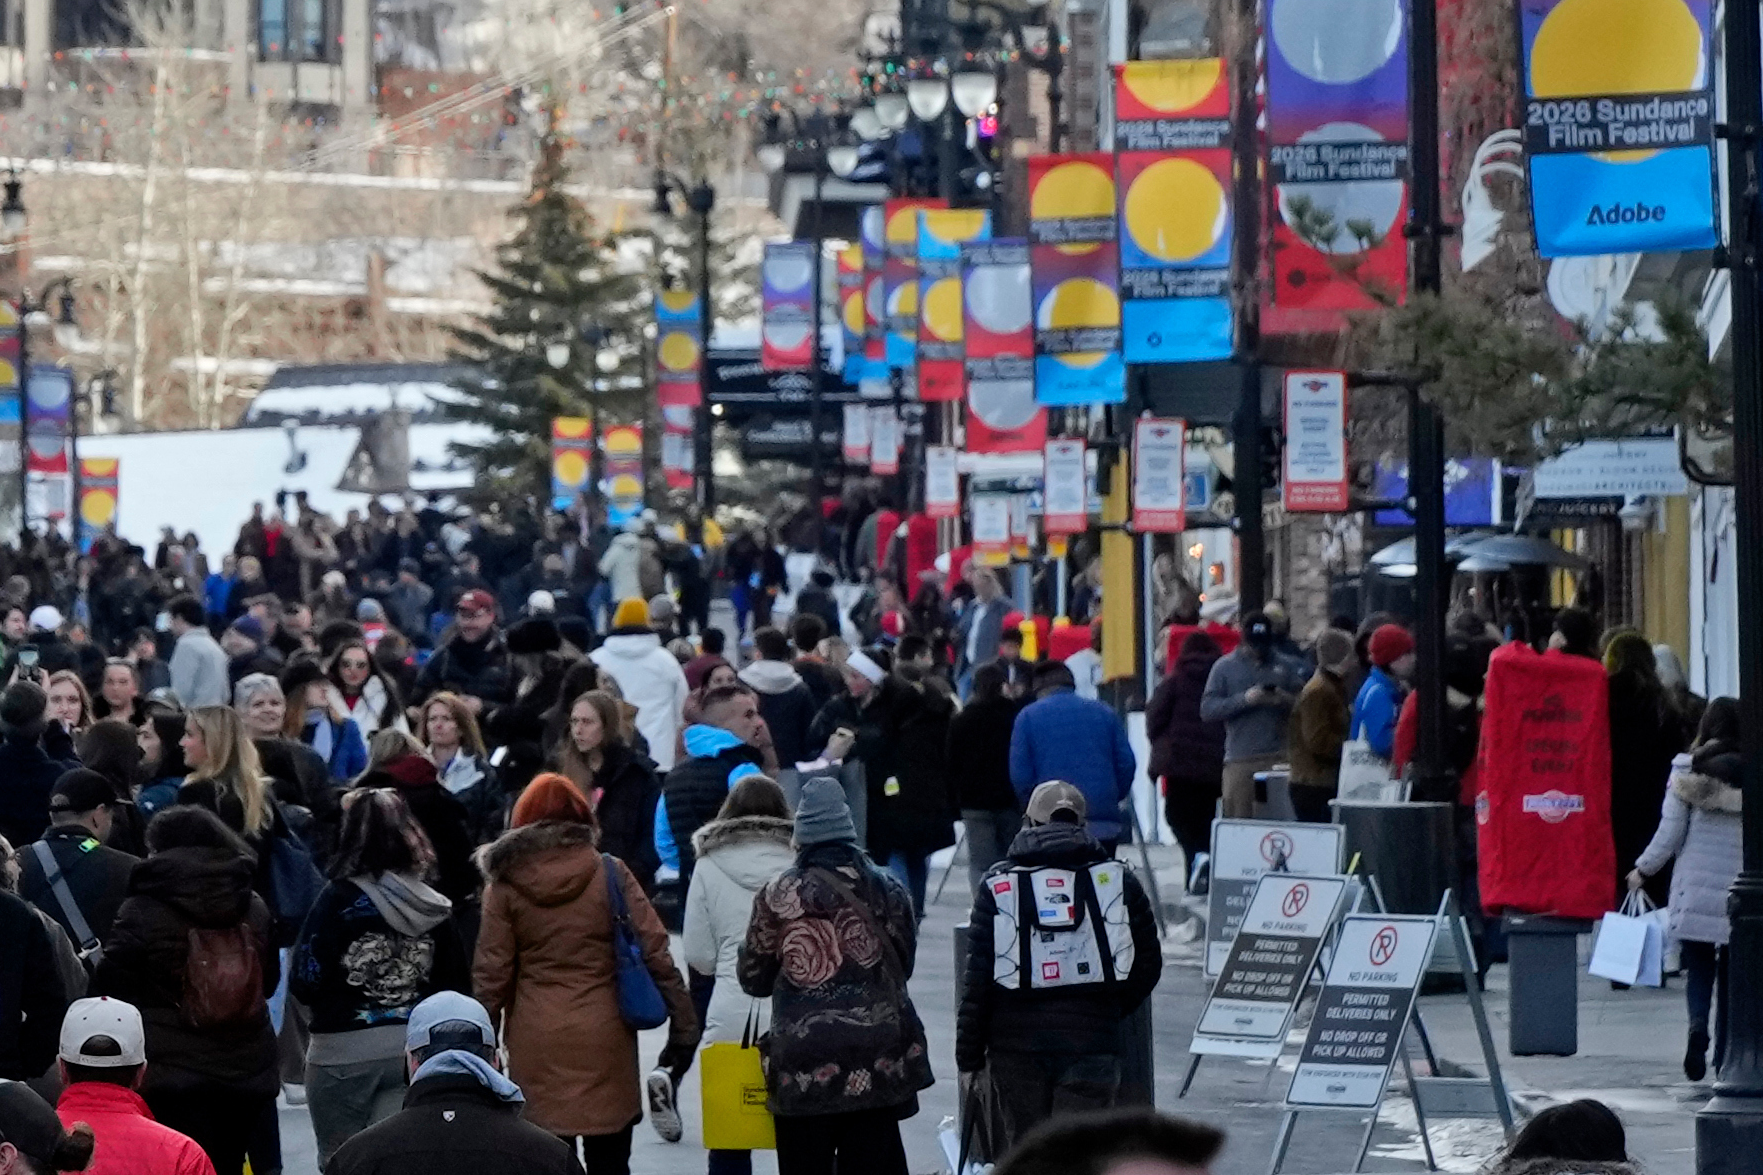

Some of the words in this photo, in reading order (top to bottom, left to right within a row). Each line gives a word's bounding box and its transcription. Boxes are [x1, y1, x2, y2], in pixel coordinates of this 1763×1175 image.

[1527, 100, 1591, 125] 2026
[1596, 96, 1708, 121] Sundance
[1549, 123, 1603, 148] Film
[1607, 117, 1696, 145] Festival
[1587, 201, 1666, 225] Adobe
[1254, 939, 1299, 951] PERMITTED
[1238, 951, 1281, 963] DELIVERIES
[1280, 953, 1303, 965] ONLY
[1231, 971, 1245, 981] NO
[1245, 972, 1265, 982] DROP
[1346, 972, 1361, 982] NO
[1361, 972, 1398, 983] PARKING
[1223, 984, 1243, 994] PICK
[1242, 985, 1256, 995] UP
[1254, 986, 1291, 997] ALLOWED
[1341, 992, 1390, 1006] PERMITTED
[1325, 1007, 1373, 1020] DELIVERIES
[1373, 1009, 1397, 1021] ONLY
[1319, 1030, 1334, 1042] NO
[1333, 1031, 1357, 1042] DROP
[1358, 1031, 1375, 1043] OFF
[1374, 1032, 1388, 1043] OR
[1311, 1045, 1332, 1057] PICK
[1332, 1045, 1347, 1056] UP
[1346, 1046, 1387, 1058] ALLOWED
